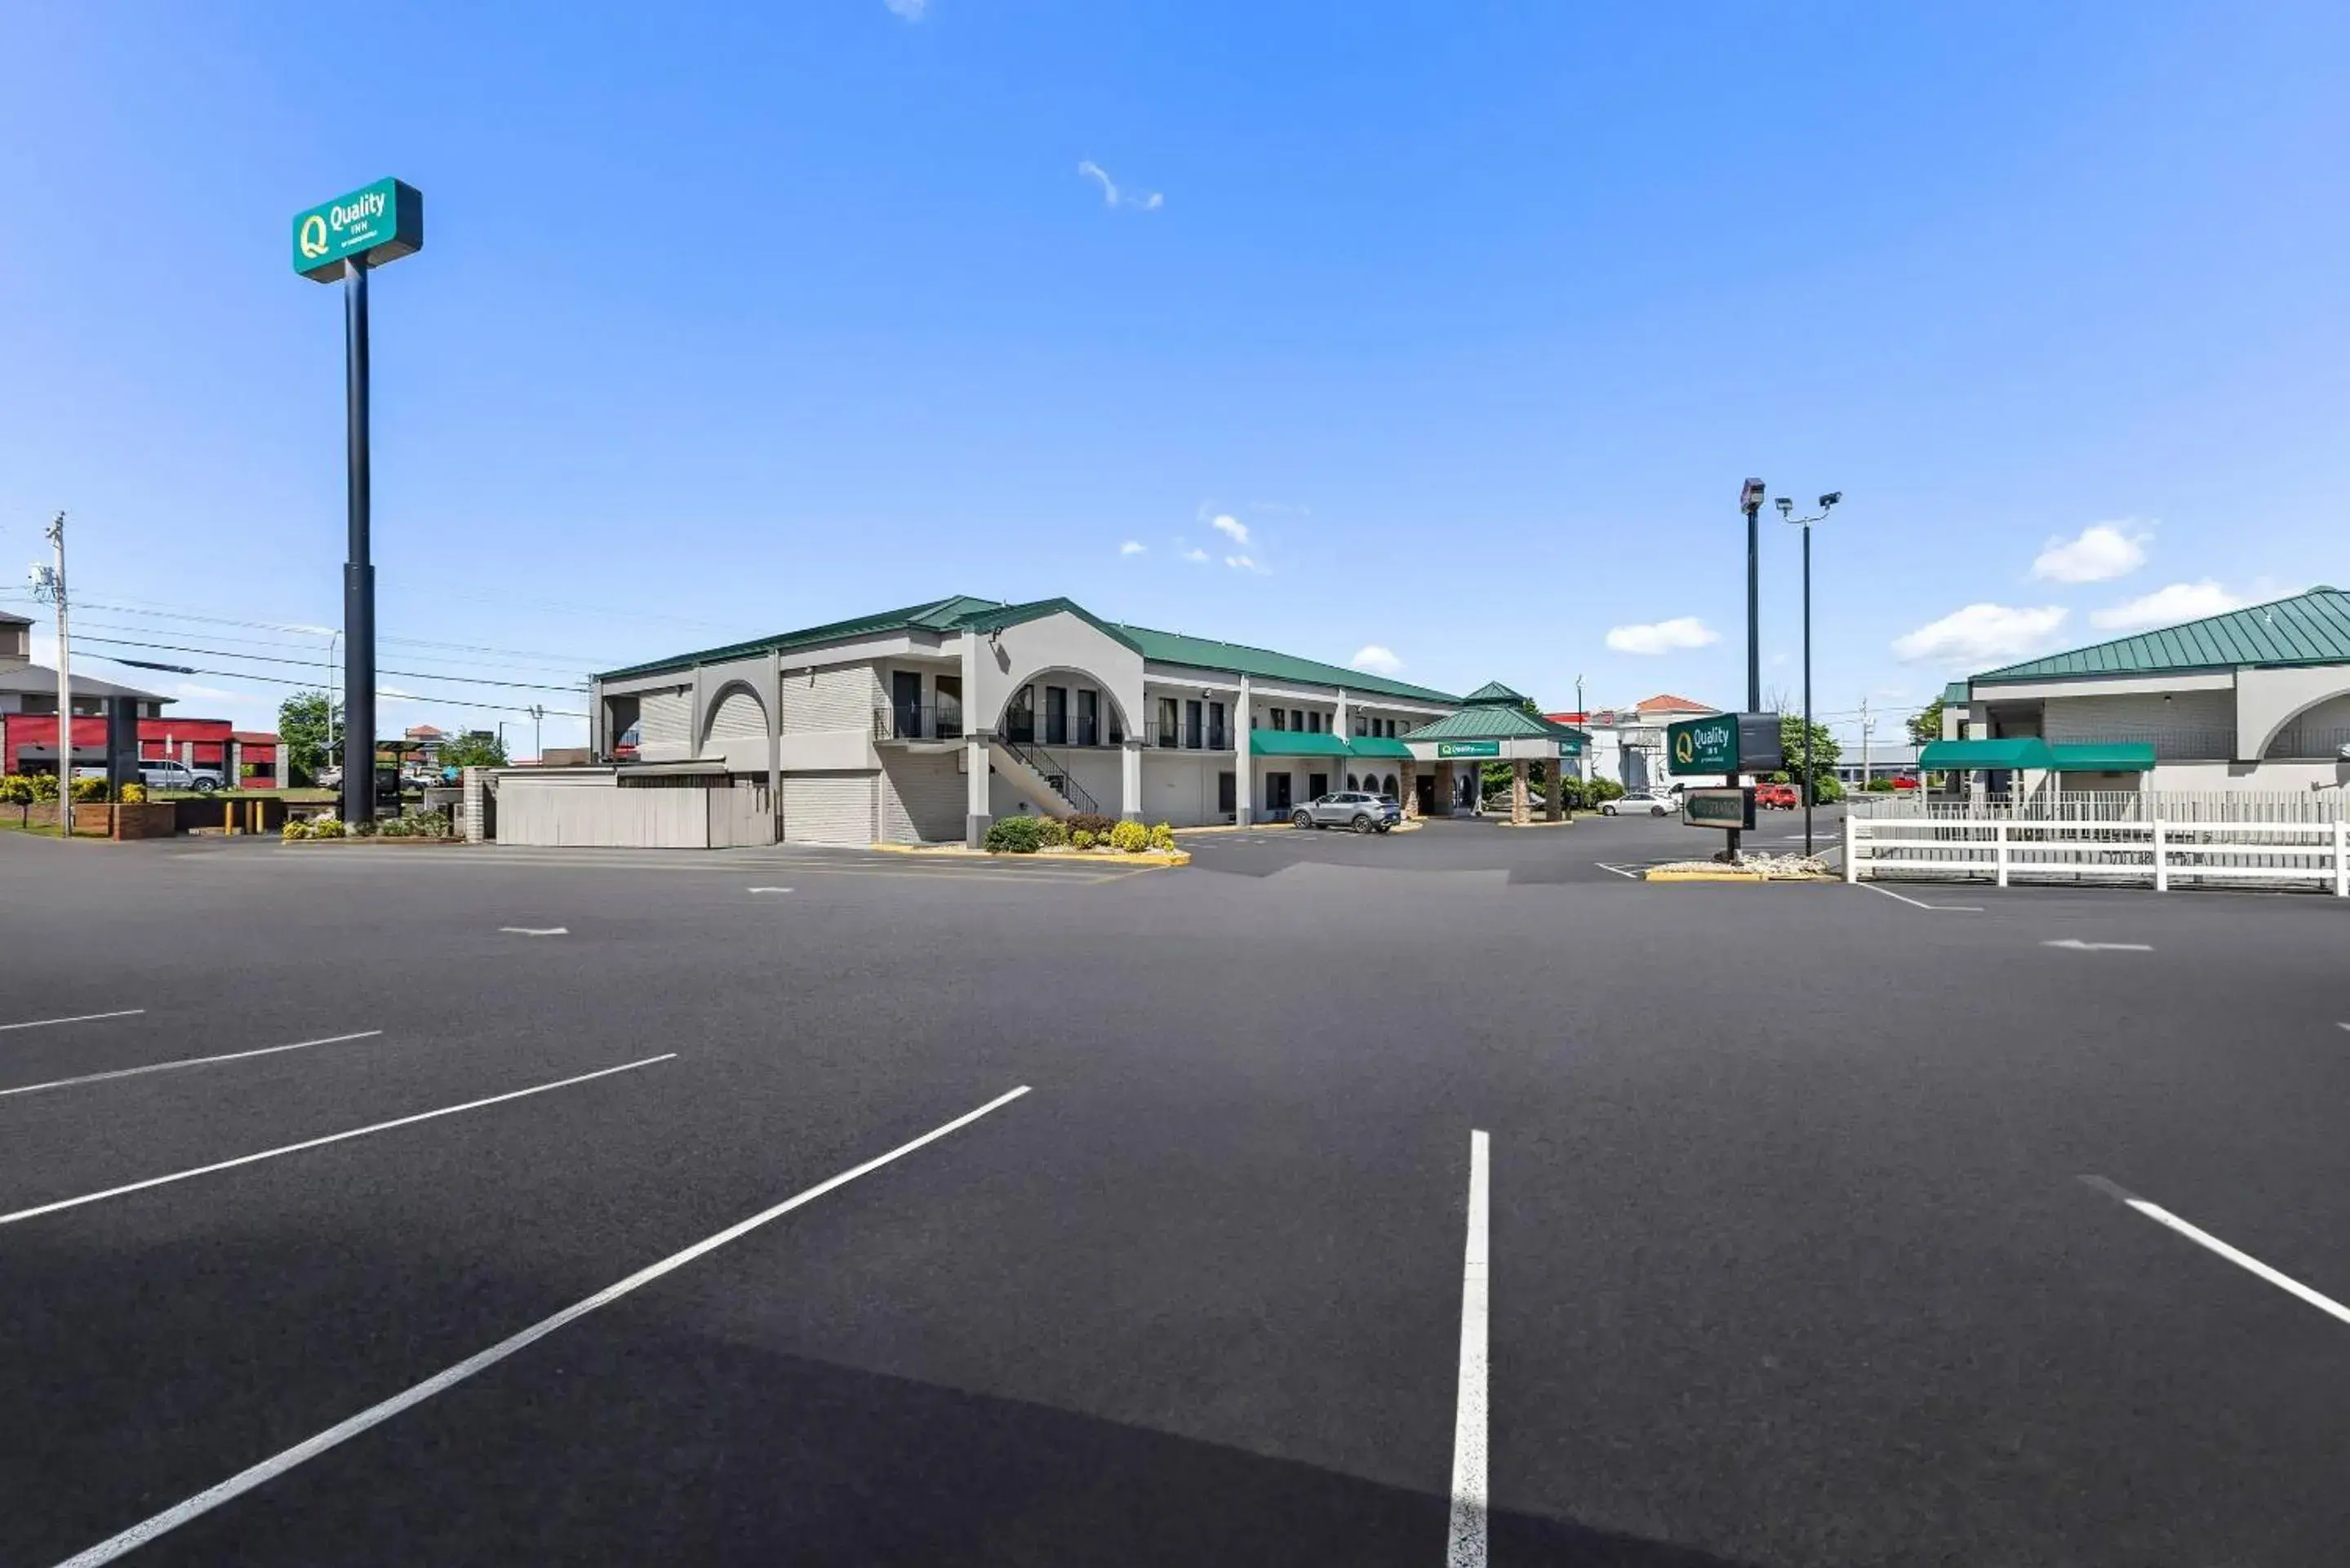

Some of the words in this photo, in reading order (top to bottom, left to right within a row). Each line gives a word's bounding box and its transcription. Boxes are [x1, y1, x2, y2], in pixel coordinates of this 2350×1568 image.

[331, 193, 385, 230] Quality
[300, 215, 330, 259] Q
[1676, 731, 1695, 764] Q
[1694, 726, 1729, 749] Quality
